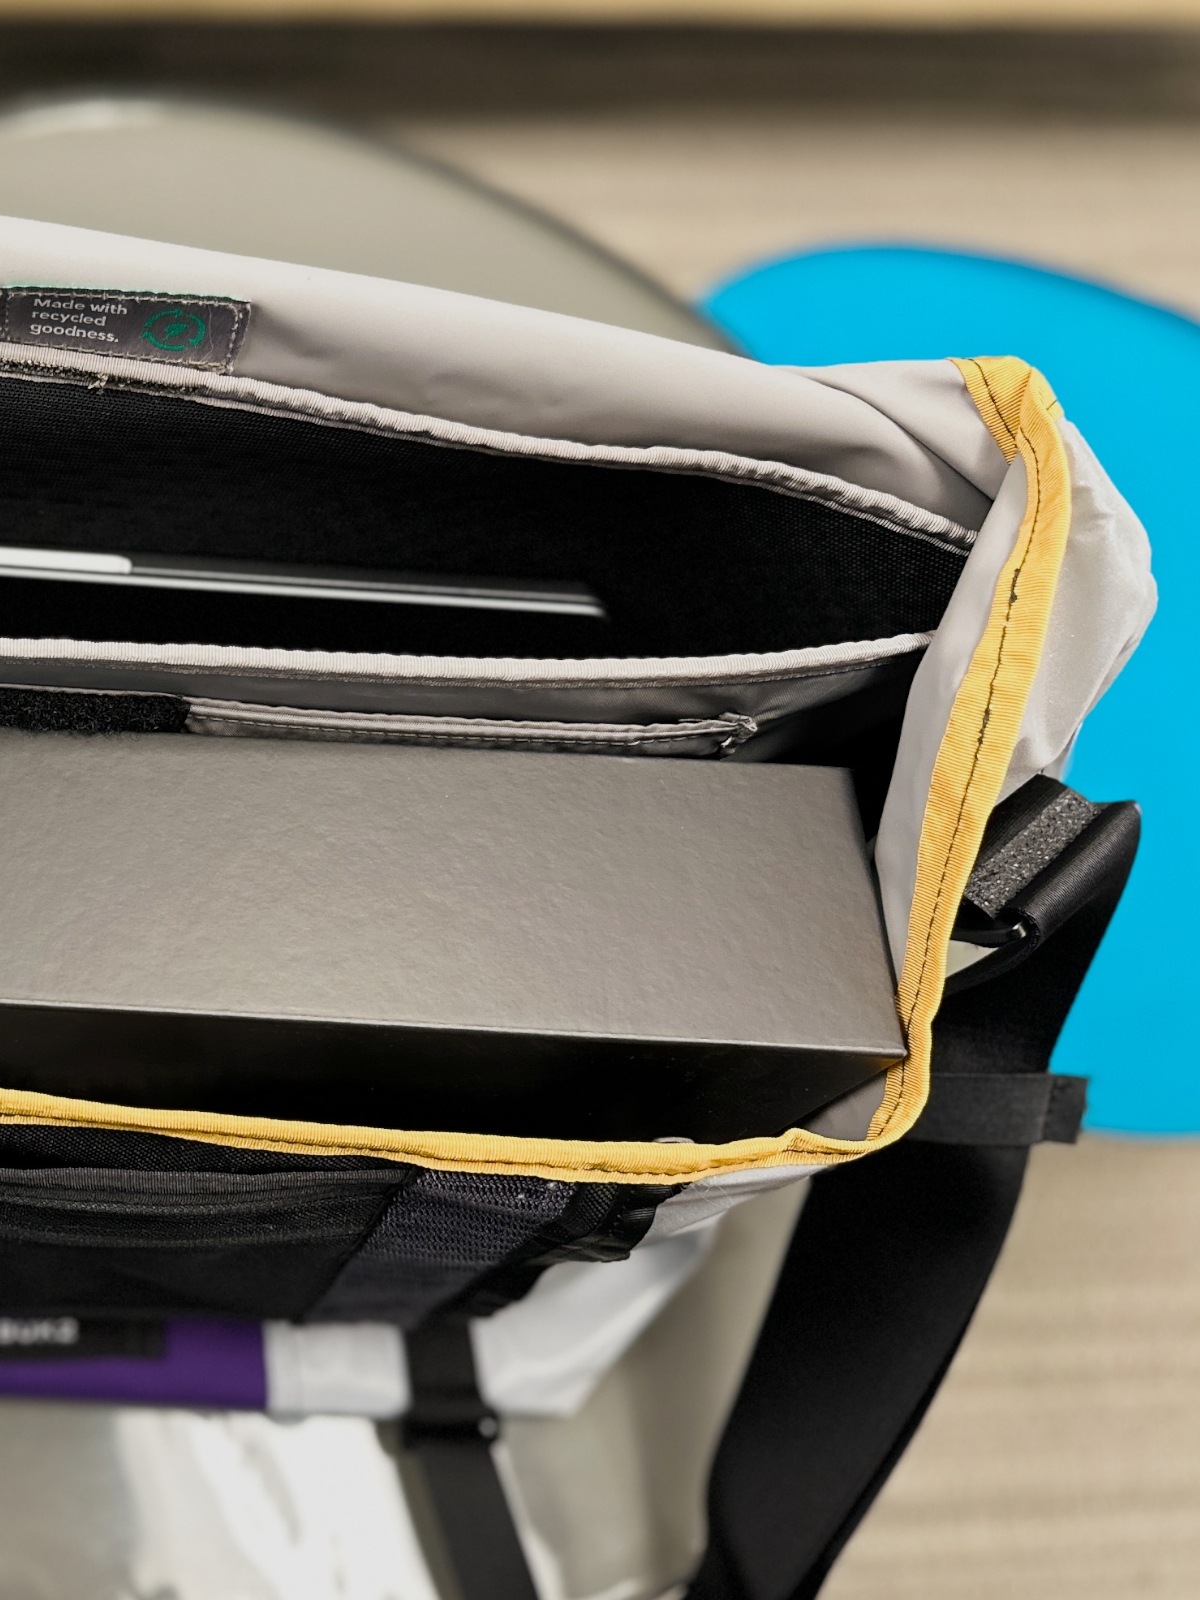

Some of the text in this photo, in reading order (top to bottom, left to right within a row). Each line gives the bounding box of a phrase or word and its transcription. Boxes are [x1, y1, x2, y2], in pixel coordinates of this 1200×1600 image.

[33, 298, 128, 316] Made with
[31, 309, 107, 327] recycled
[30, 324, 119, 342] goodness.
